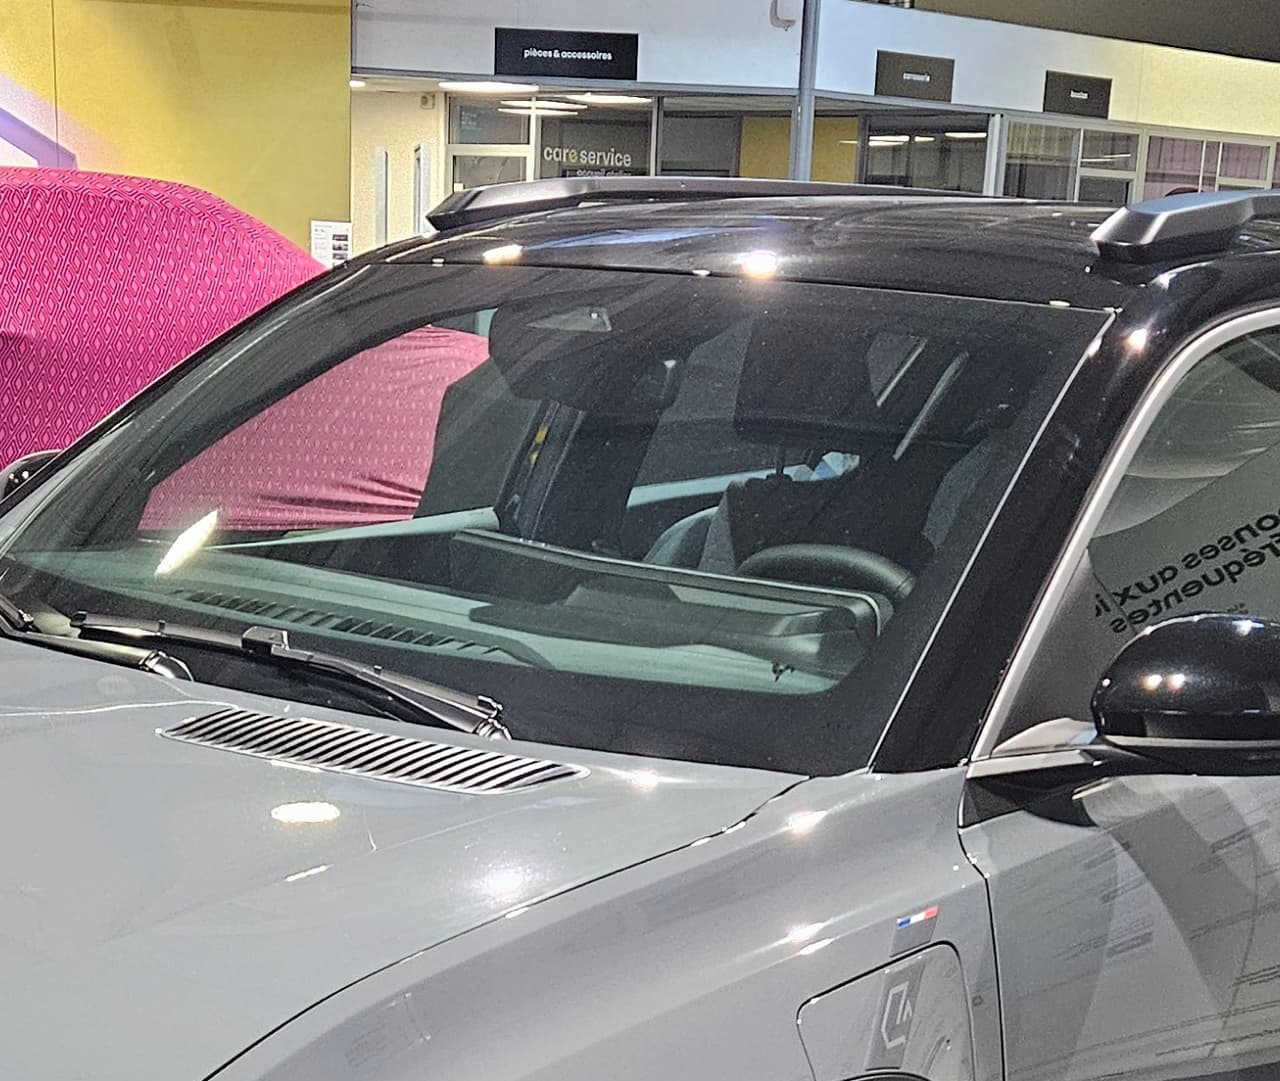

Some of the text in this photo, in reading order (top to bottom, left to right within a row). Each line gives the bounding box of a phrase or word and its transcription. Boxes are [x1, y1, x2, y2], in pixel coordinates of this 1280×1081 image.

[523, 47, 552, 58] pièces
[560, 50, 612, 60] accessoires
[544, 146, 631, 167] care service
